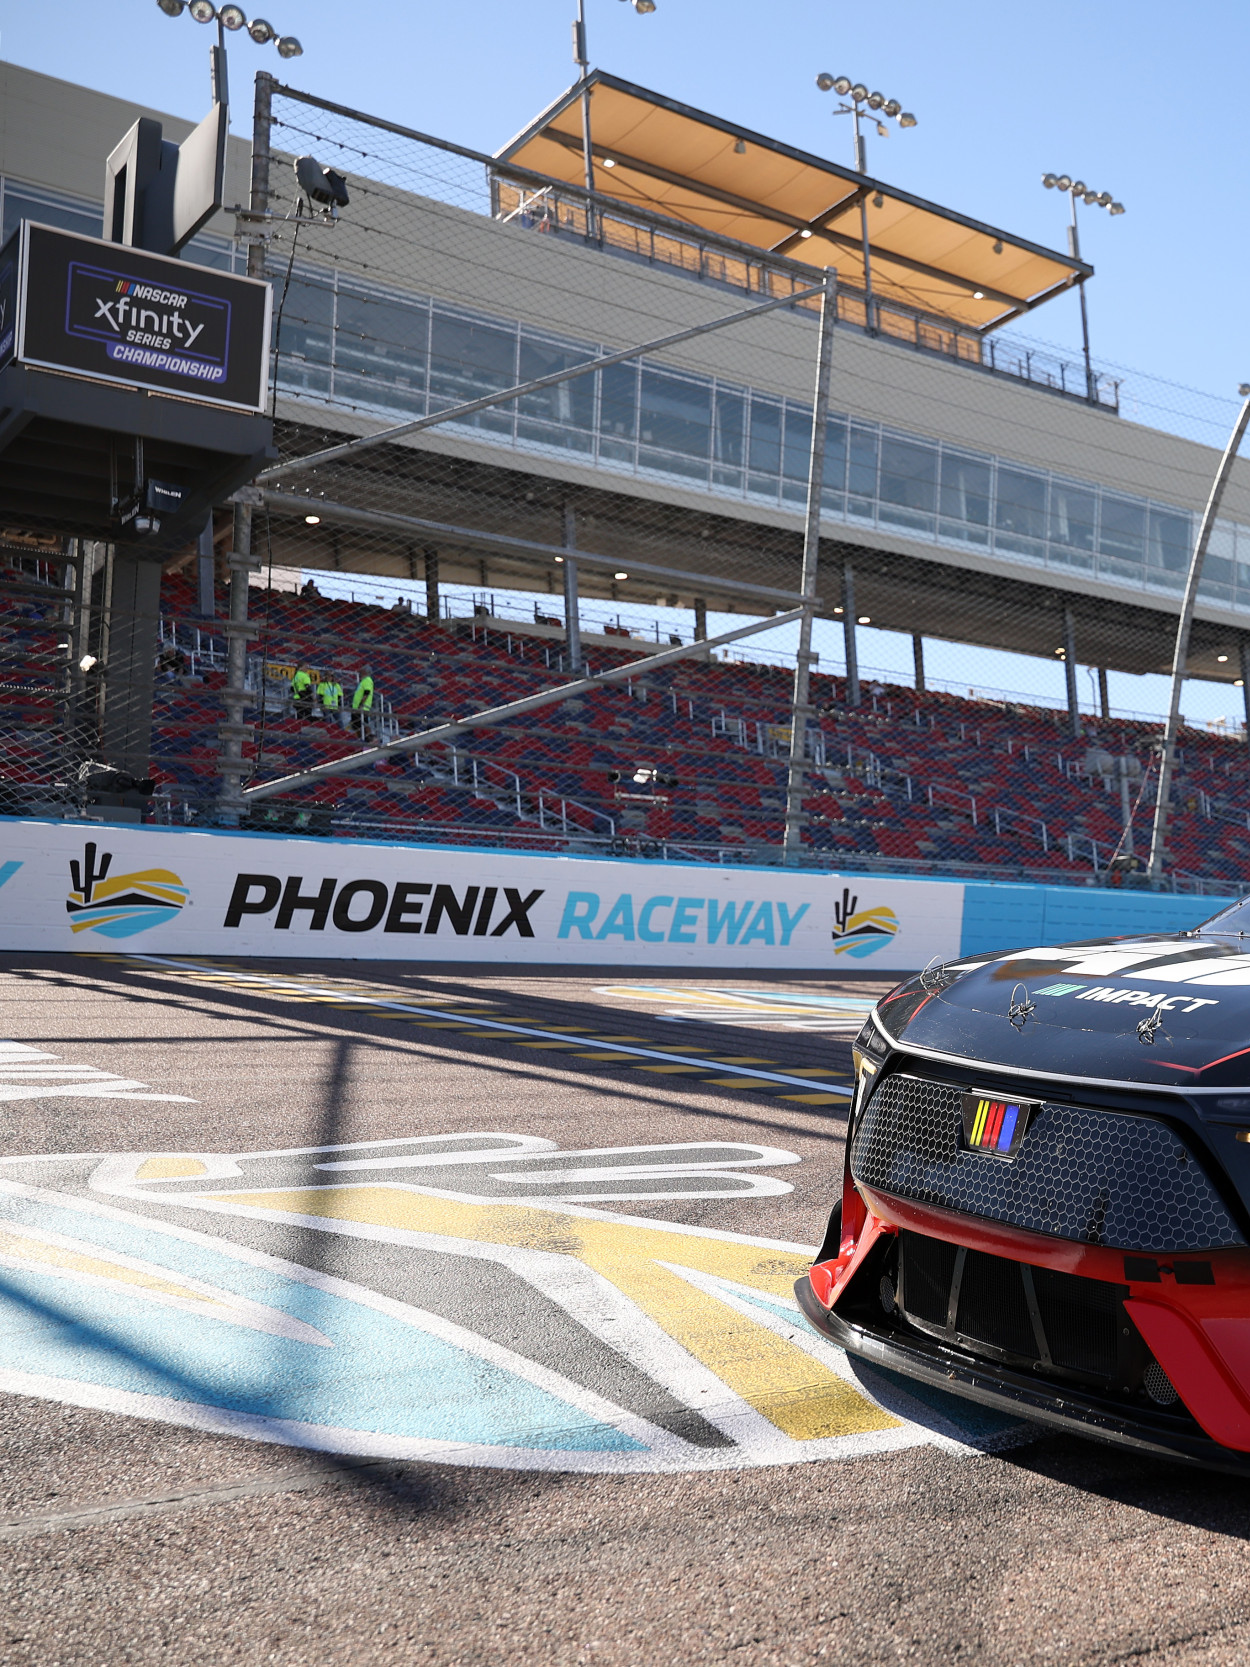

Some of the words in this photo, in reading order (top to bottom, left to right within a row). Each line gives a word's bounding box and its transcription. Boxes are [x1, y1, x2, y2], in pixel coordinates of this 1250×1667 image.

[133, 283, 187, 309] NASCAR
[94, 297, 205, 347] xfinity
[126, 330, 172, 350] SERIES
[112, 345, 223, 380] CHAMPIONSHIP
[223, 873, 546, 938] PHOENIX
[556, 890, 811, 946] RACEWAY
[1076, 986, 1220, 1014] IMPACT
